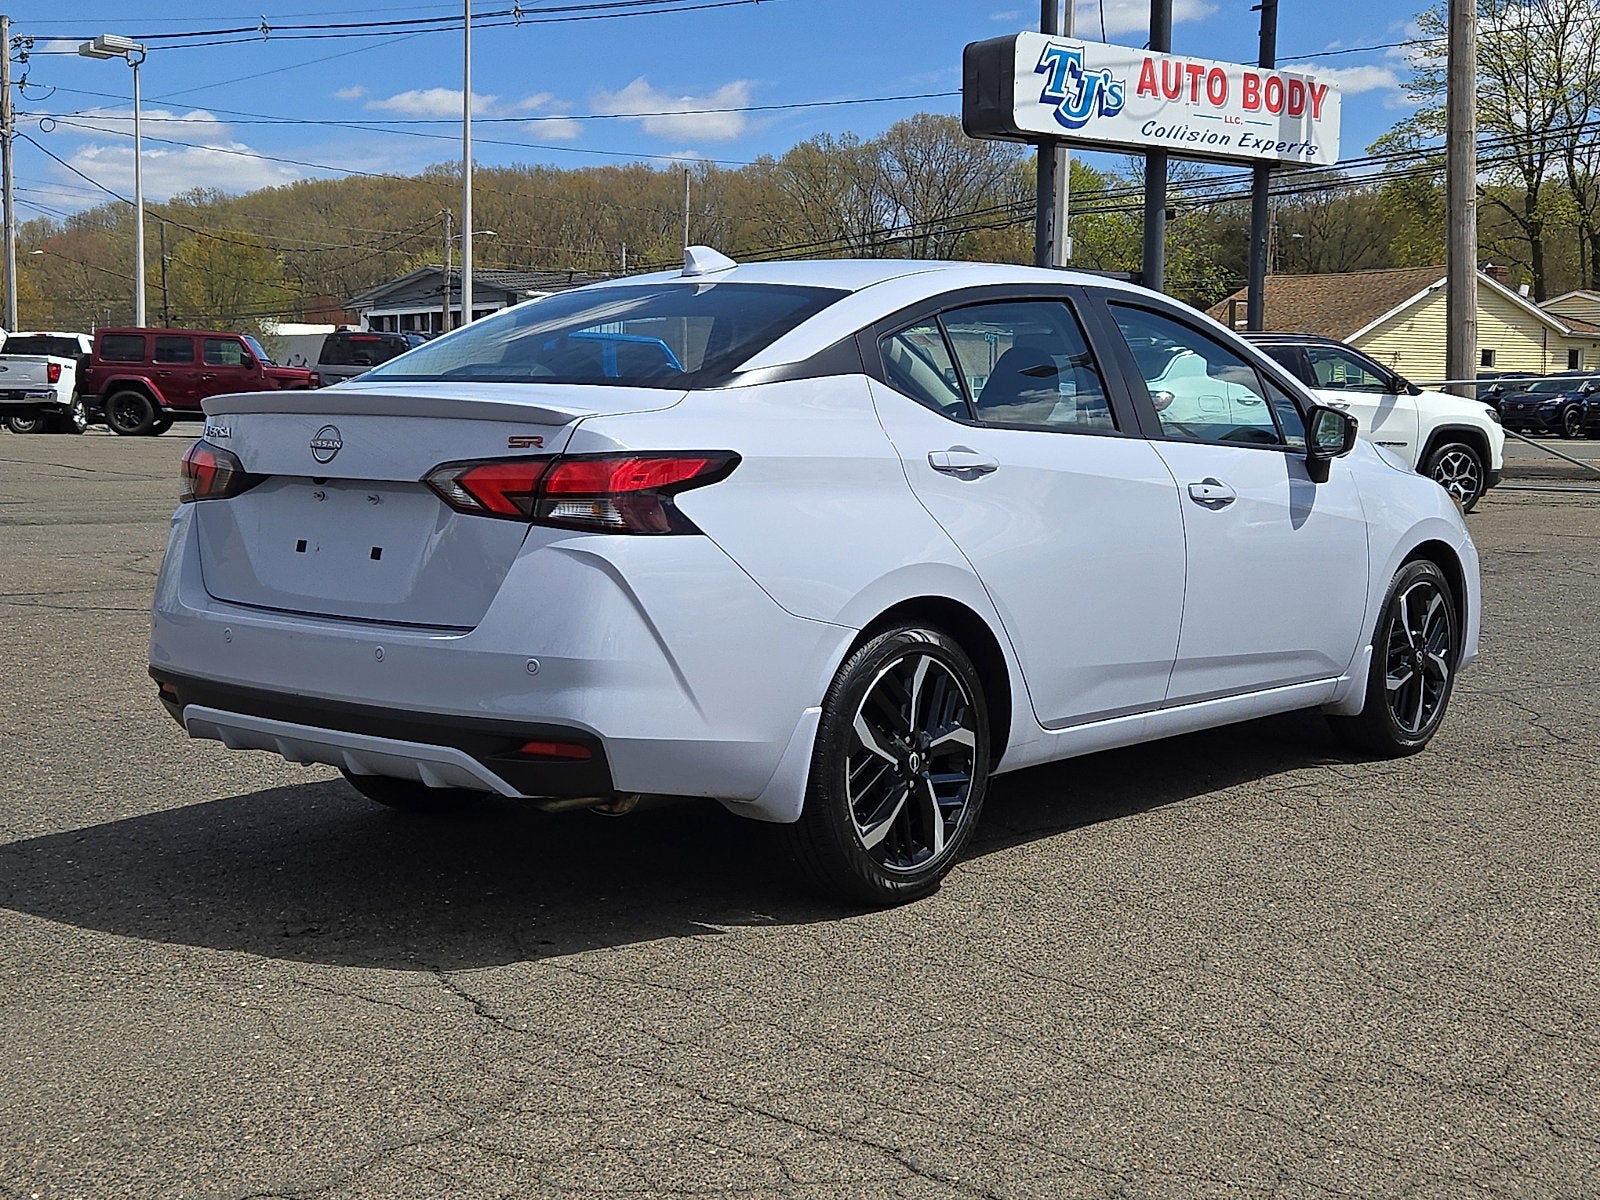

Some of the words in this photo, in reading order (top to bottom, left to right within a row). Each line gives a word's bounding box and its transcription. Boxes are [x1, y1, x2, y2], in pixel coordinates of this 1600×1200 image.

[1034, 41, 1126, 129] TJ's
[1136, 57, 1229, 107] AUTO
[1242, 71, 1328, 119] BODY
[1223, 115, 1243, 126] LLC.
[1141, 120, 1231, 146] Collision
[1238, 132, 1319, 156] Experts
[310, 439, 342, 449] NISSAN
[508, 435, 544, 449] SR
